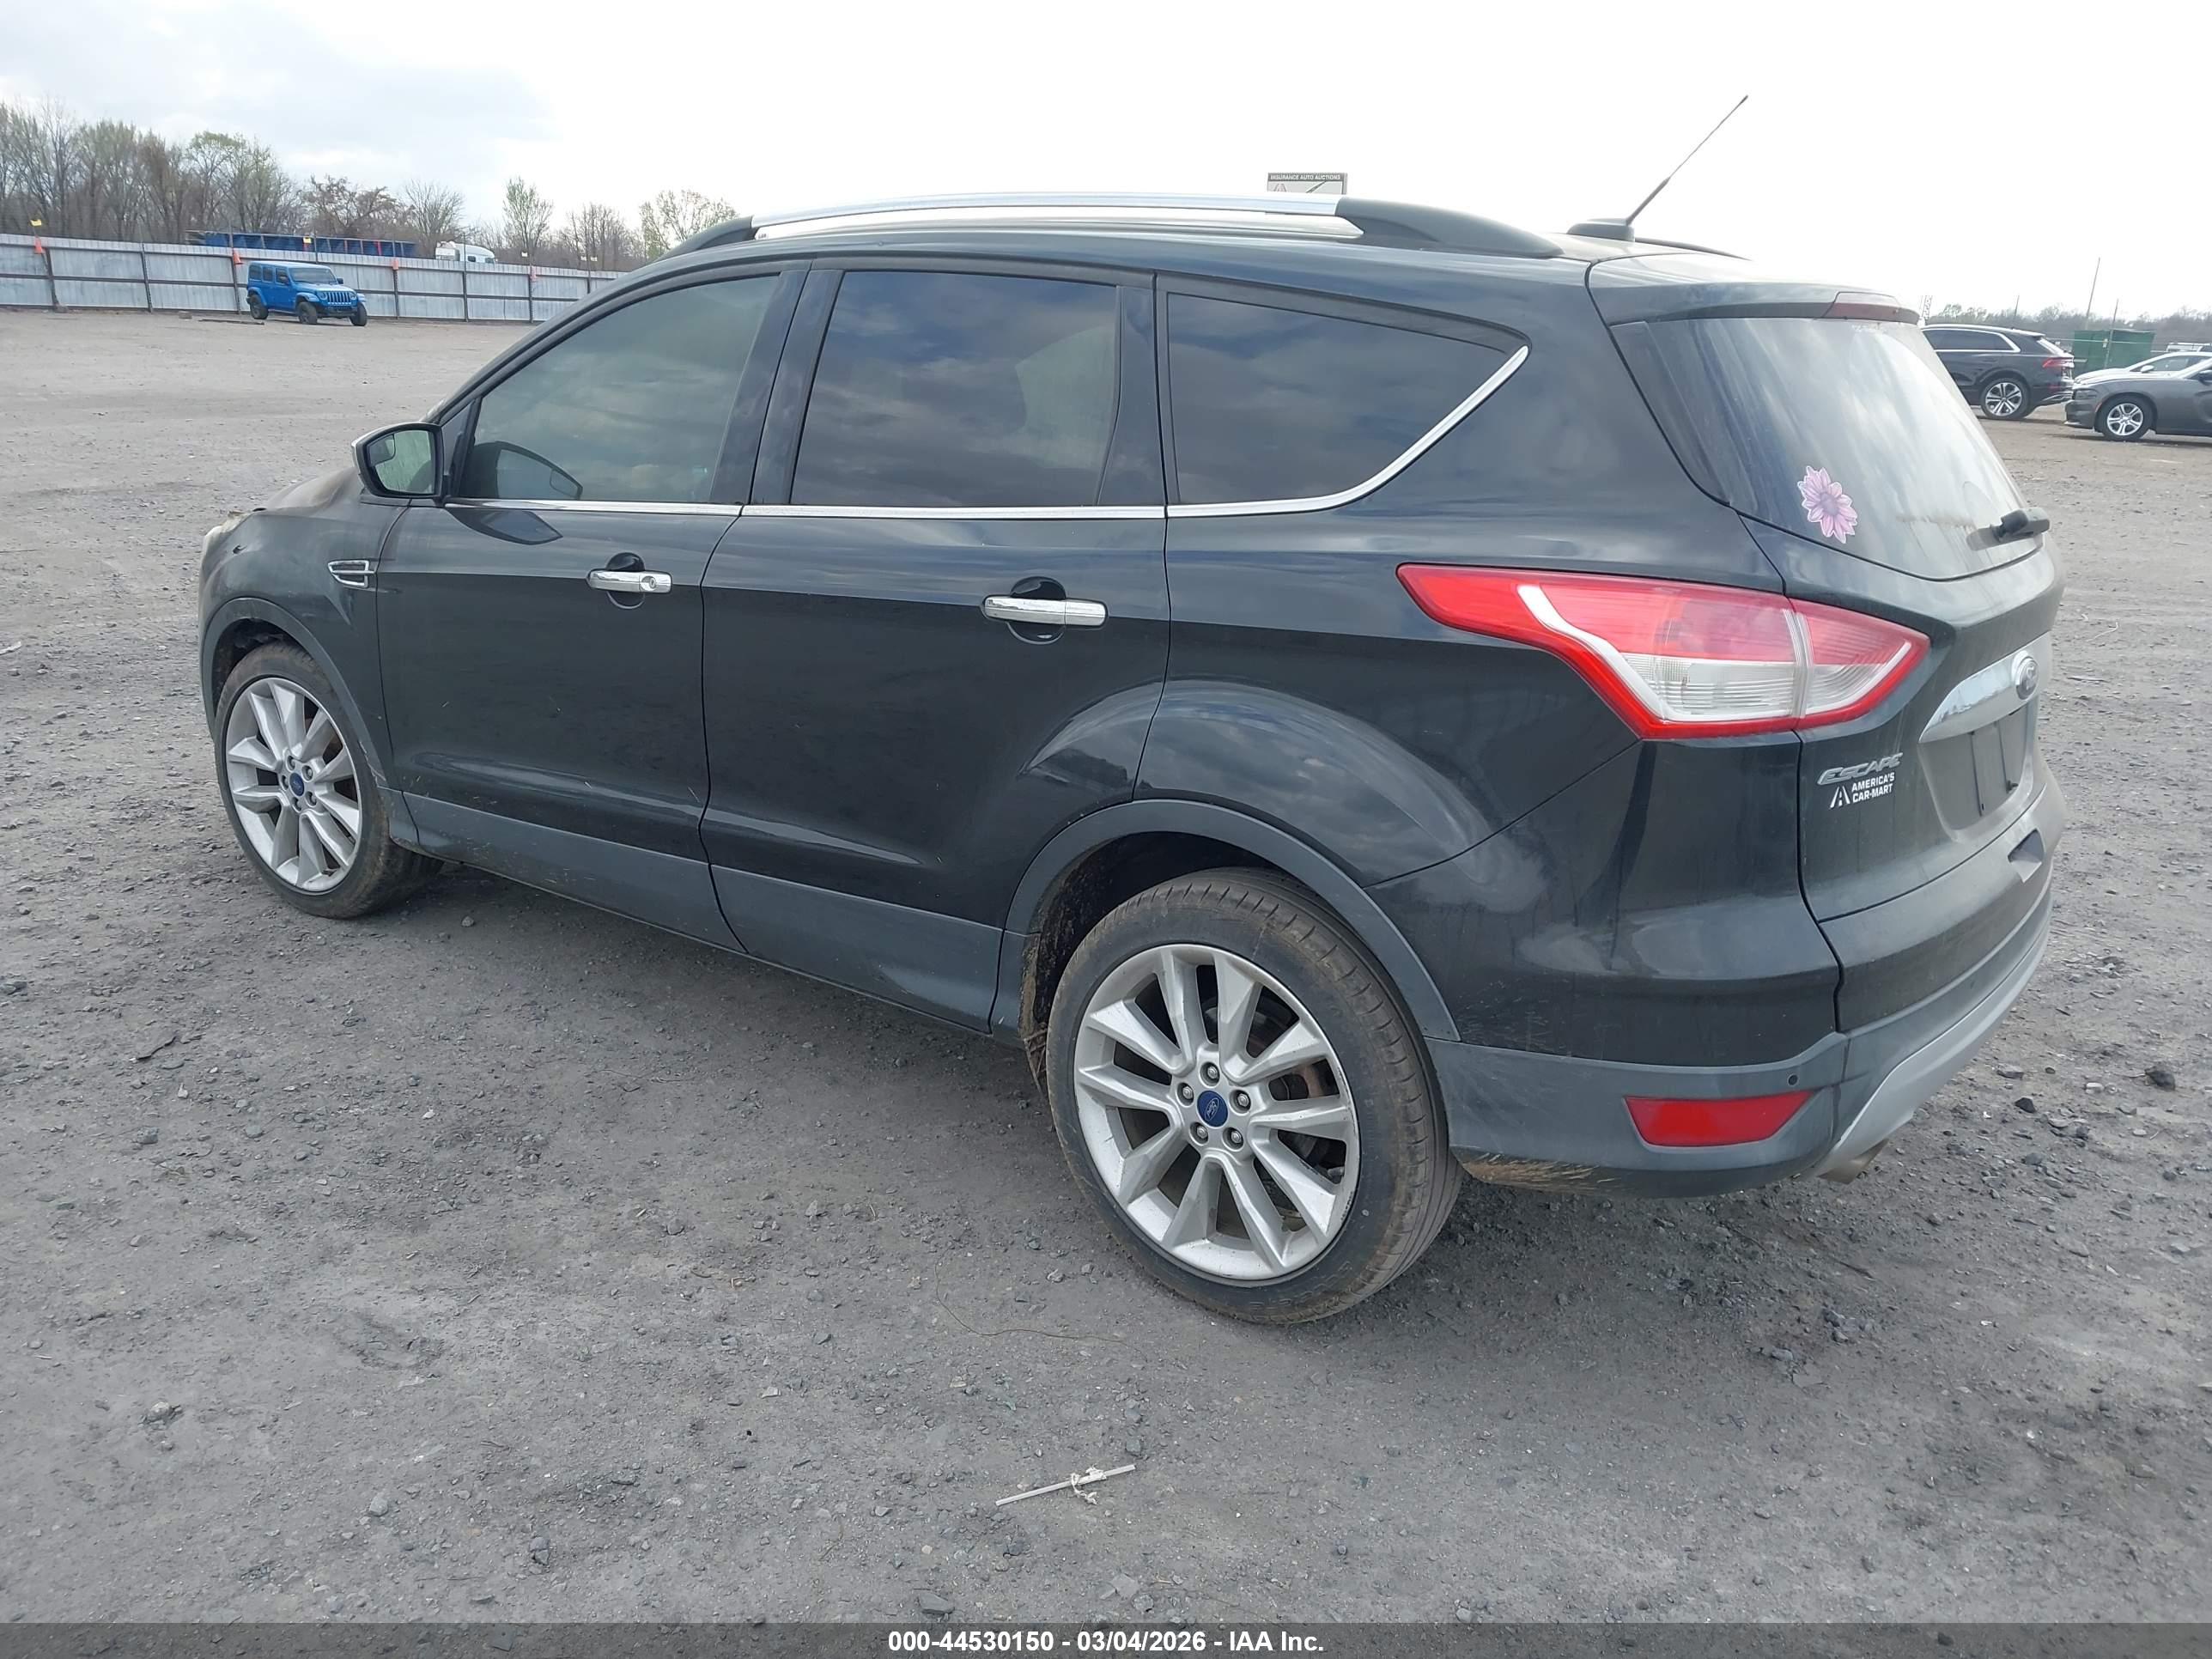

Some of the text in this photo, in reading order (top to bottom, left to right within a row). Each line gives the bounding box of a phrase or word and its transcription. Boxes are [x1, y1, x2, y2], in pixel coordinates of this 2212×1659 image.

[1817, 752, 1903, 786] ESCAPE
[1851, 772, 1895, 793] AMERICA'S
[1852, 783, 1893, 803] CAR-MART
